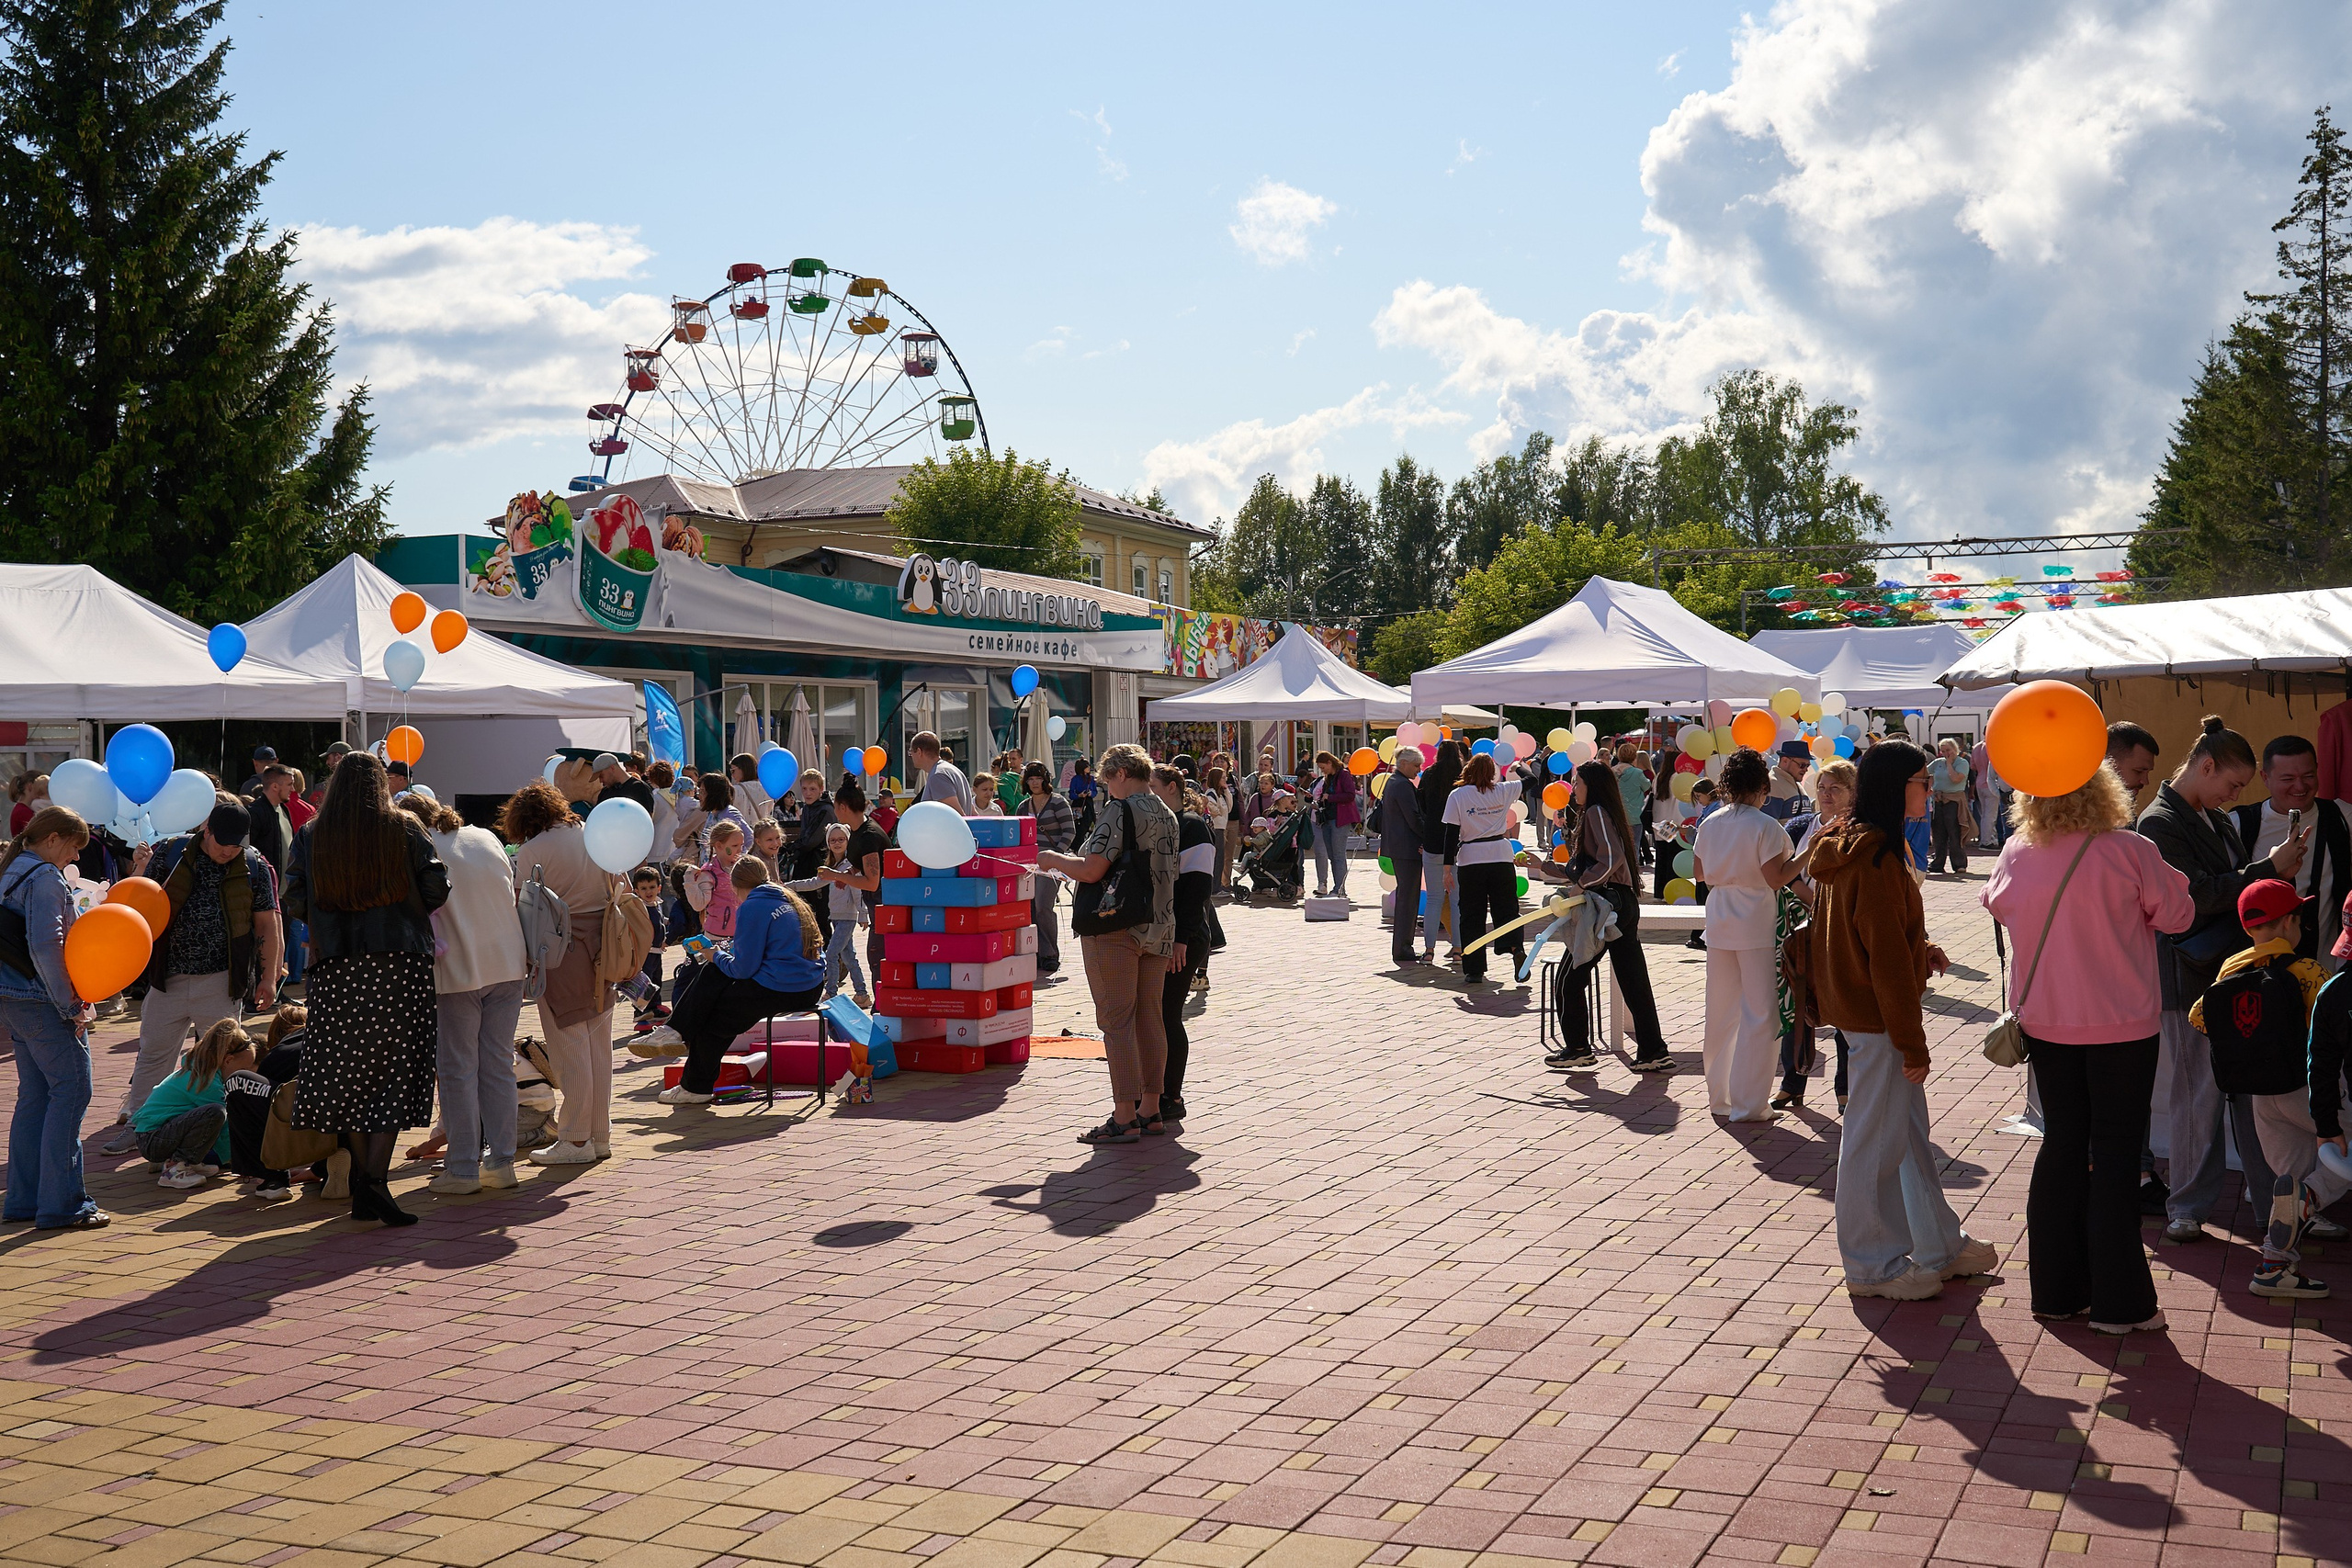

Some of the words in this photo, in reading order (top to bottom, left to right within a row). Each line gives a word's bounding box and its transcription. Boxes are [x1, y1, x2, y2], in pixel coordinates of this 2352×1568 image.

[600, 578, 620, 604] 33
[939, 557, 983, 618] 33
[968, 633, 1040, 654] семейное
[1044, 638, 1078, 661] кафе
